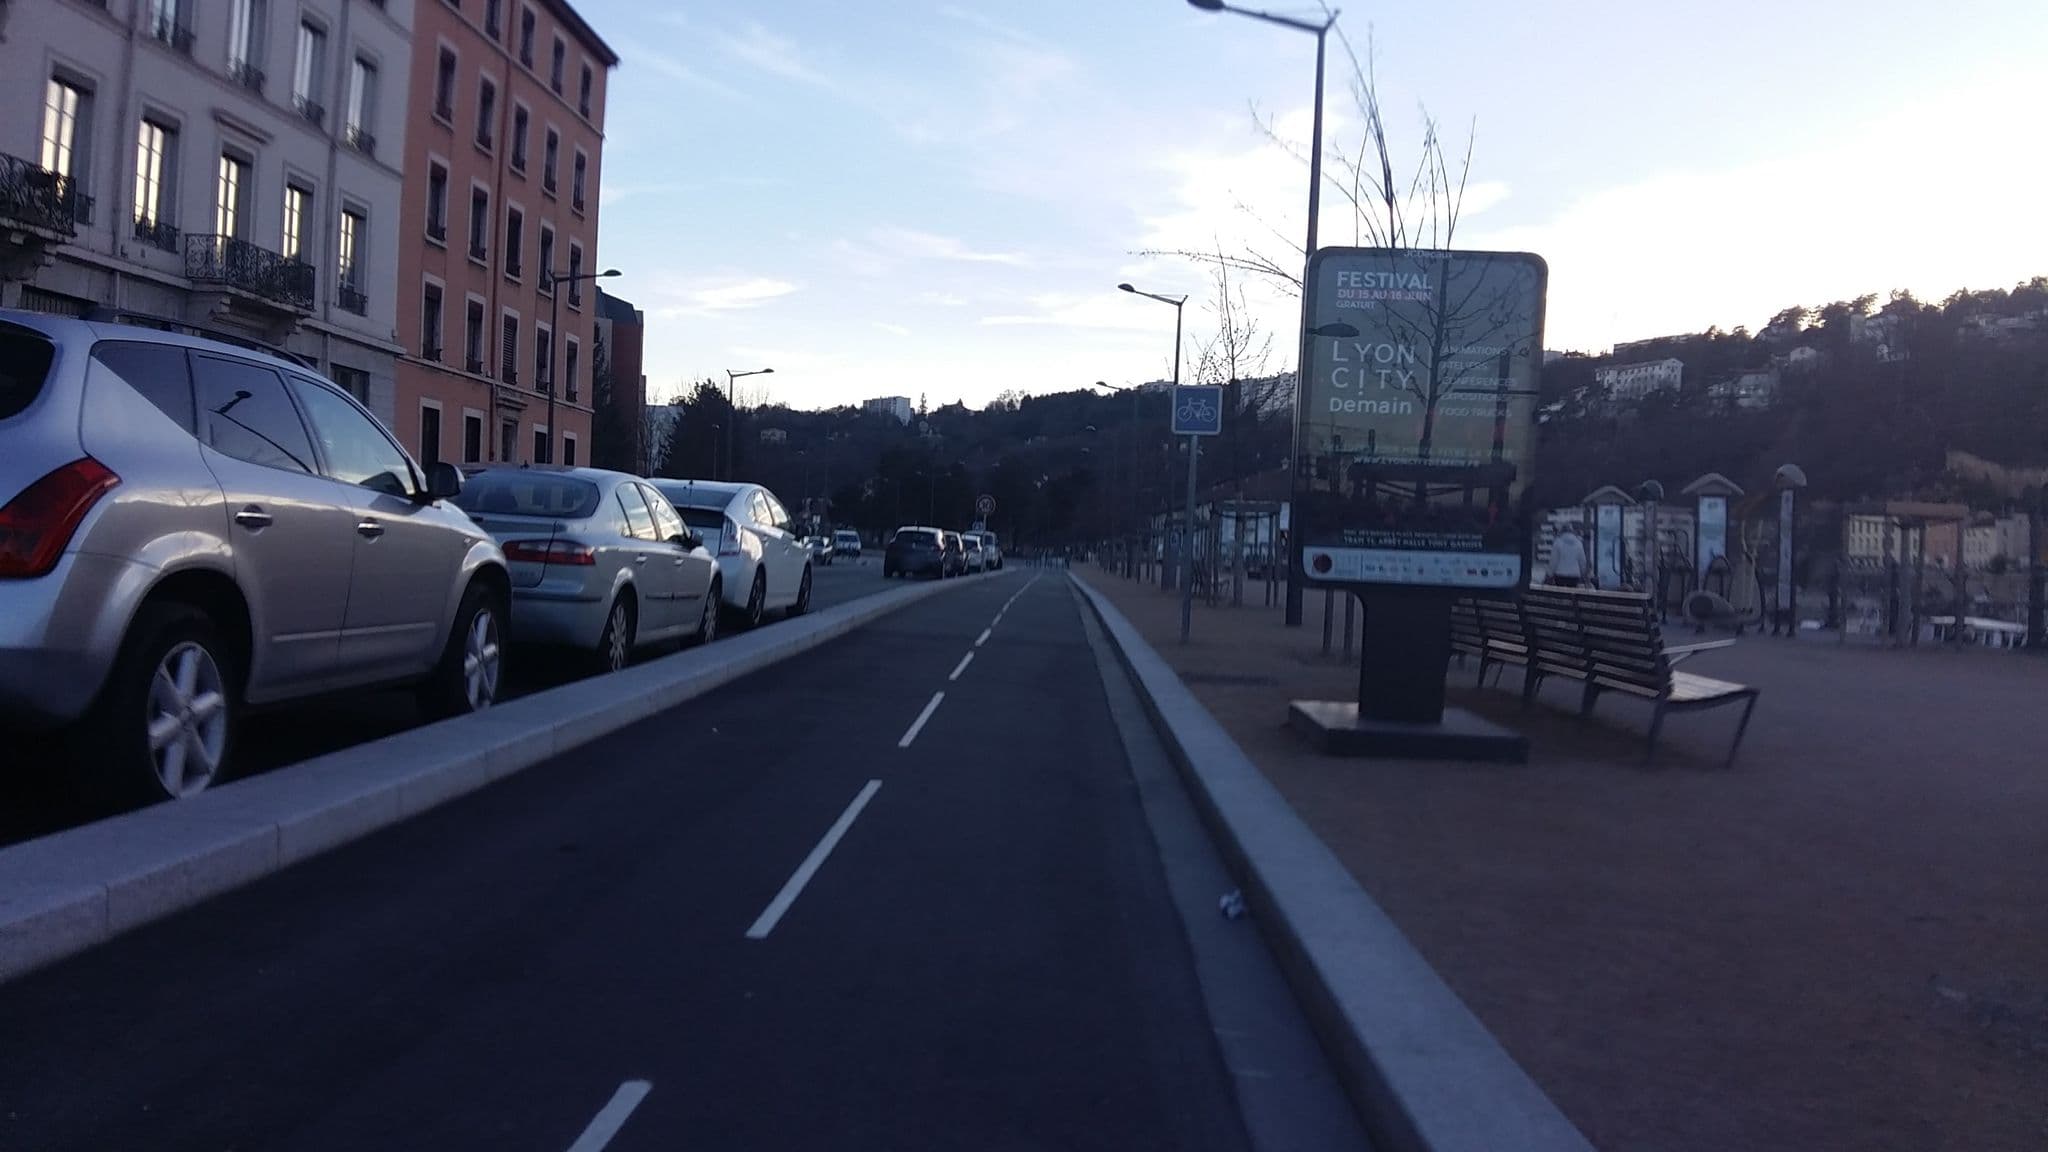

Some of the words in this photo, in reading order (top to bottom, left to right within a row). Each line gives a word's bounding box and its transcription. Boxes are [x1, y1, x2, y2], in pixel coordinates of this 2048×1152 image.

[1337, 271, 1433, 289] FESTIVAL
[1337, 288, 1354, 299] DU
[1359, 289, 1369, 299] 15
[1371, 289, 1388, 300] AU
[1405, 290, 1432, 301] JUIN
[1336, 300, 1376, 309] GRATUIT
[1332, 340, 1415, 364] LYON
[1330, 397, 1411, 414] Demain
[1439, 407, 1470, 417] FOOD
